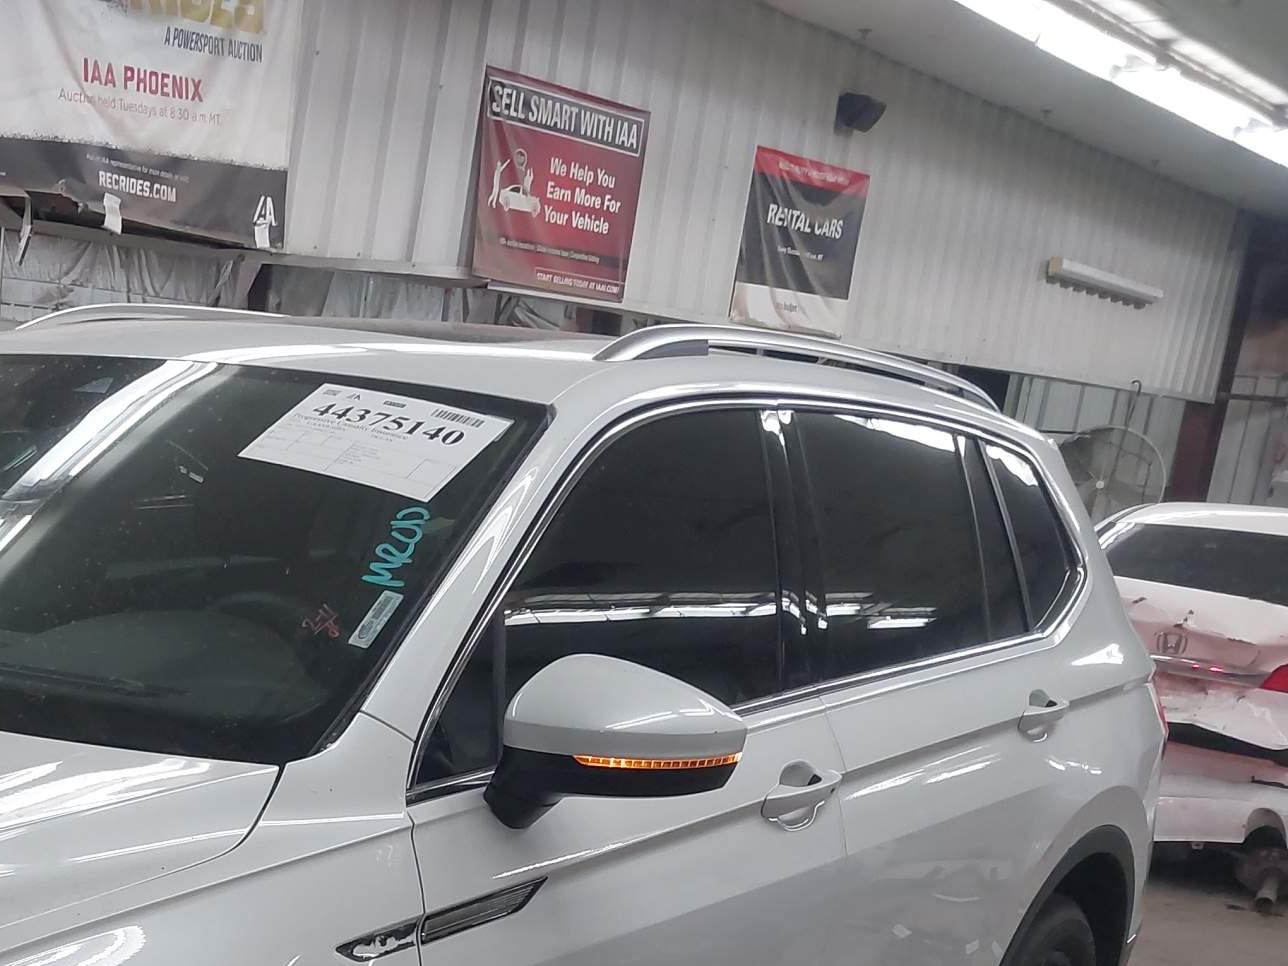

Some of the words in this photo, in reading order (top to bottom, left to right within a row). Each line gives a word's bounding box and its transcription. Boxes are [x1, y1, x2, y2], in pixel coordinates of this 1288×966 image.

[164, 26, 171, 46] A
[172, 27, 225, 57] POWERSPORT
[227, 39, 263, 63] AUCTION
[83, 57, 117, 89] IAA
[123, 65, 204, 102] PHOENIX
[118, 99, 157, 119] Tuesdays
[159, 107, 169, 118] at
[492, 84, 526, 120] SELL
[528, 95, 579, 131] SMART
[580, 108, 615, 143] WITH
[614, 119, 638, 149] IAA
[98, 170, 177, 203] RECRIDES.COM
[550, 156, 567, 176] We
[570, 162, 594, 187] Help
[595, 168, 616, 189] You
[546, 181, 571, 202] Earn
[573, 187, 602, 209] More
[603, 193, 622, 214] For
[544, 204, 569, 225] Your
[571, 210, 610, 235] Vehicle
[766, 203, 812, 234] RENTAL
[312, 402, 466, 446] 44375140
